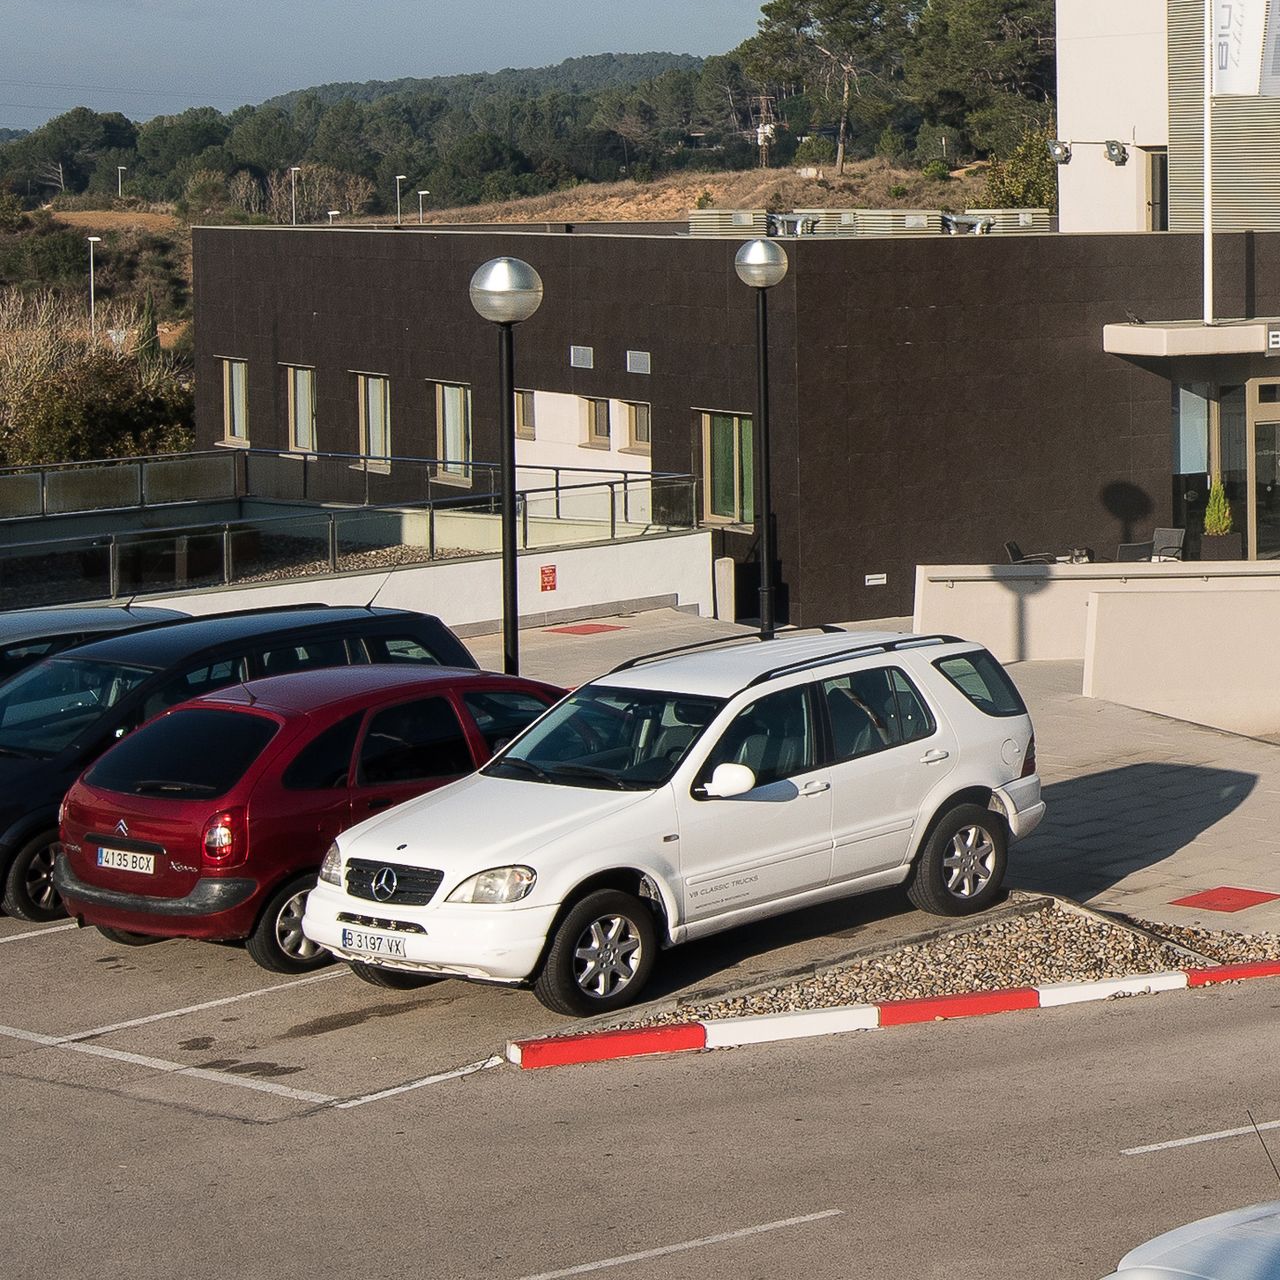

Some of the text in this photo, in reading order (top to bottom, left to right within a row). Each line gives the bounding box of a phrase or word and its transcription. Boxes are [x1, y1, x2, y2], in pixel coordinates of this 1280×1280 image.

[104, 852, 152, 872] 4135 BCX
[700, 883, 730, 896] CLASSIC
[732, 874, 759, 886] TRUCKS
[347, 931, 402, 955] B 3197 VX
